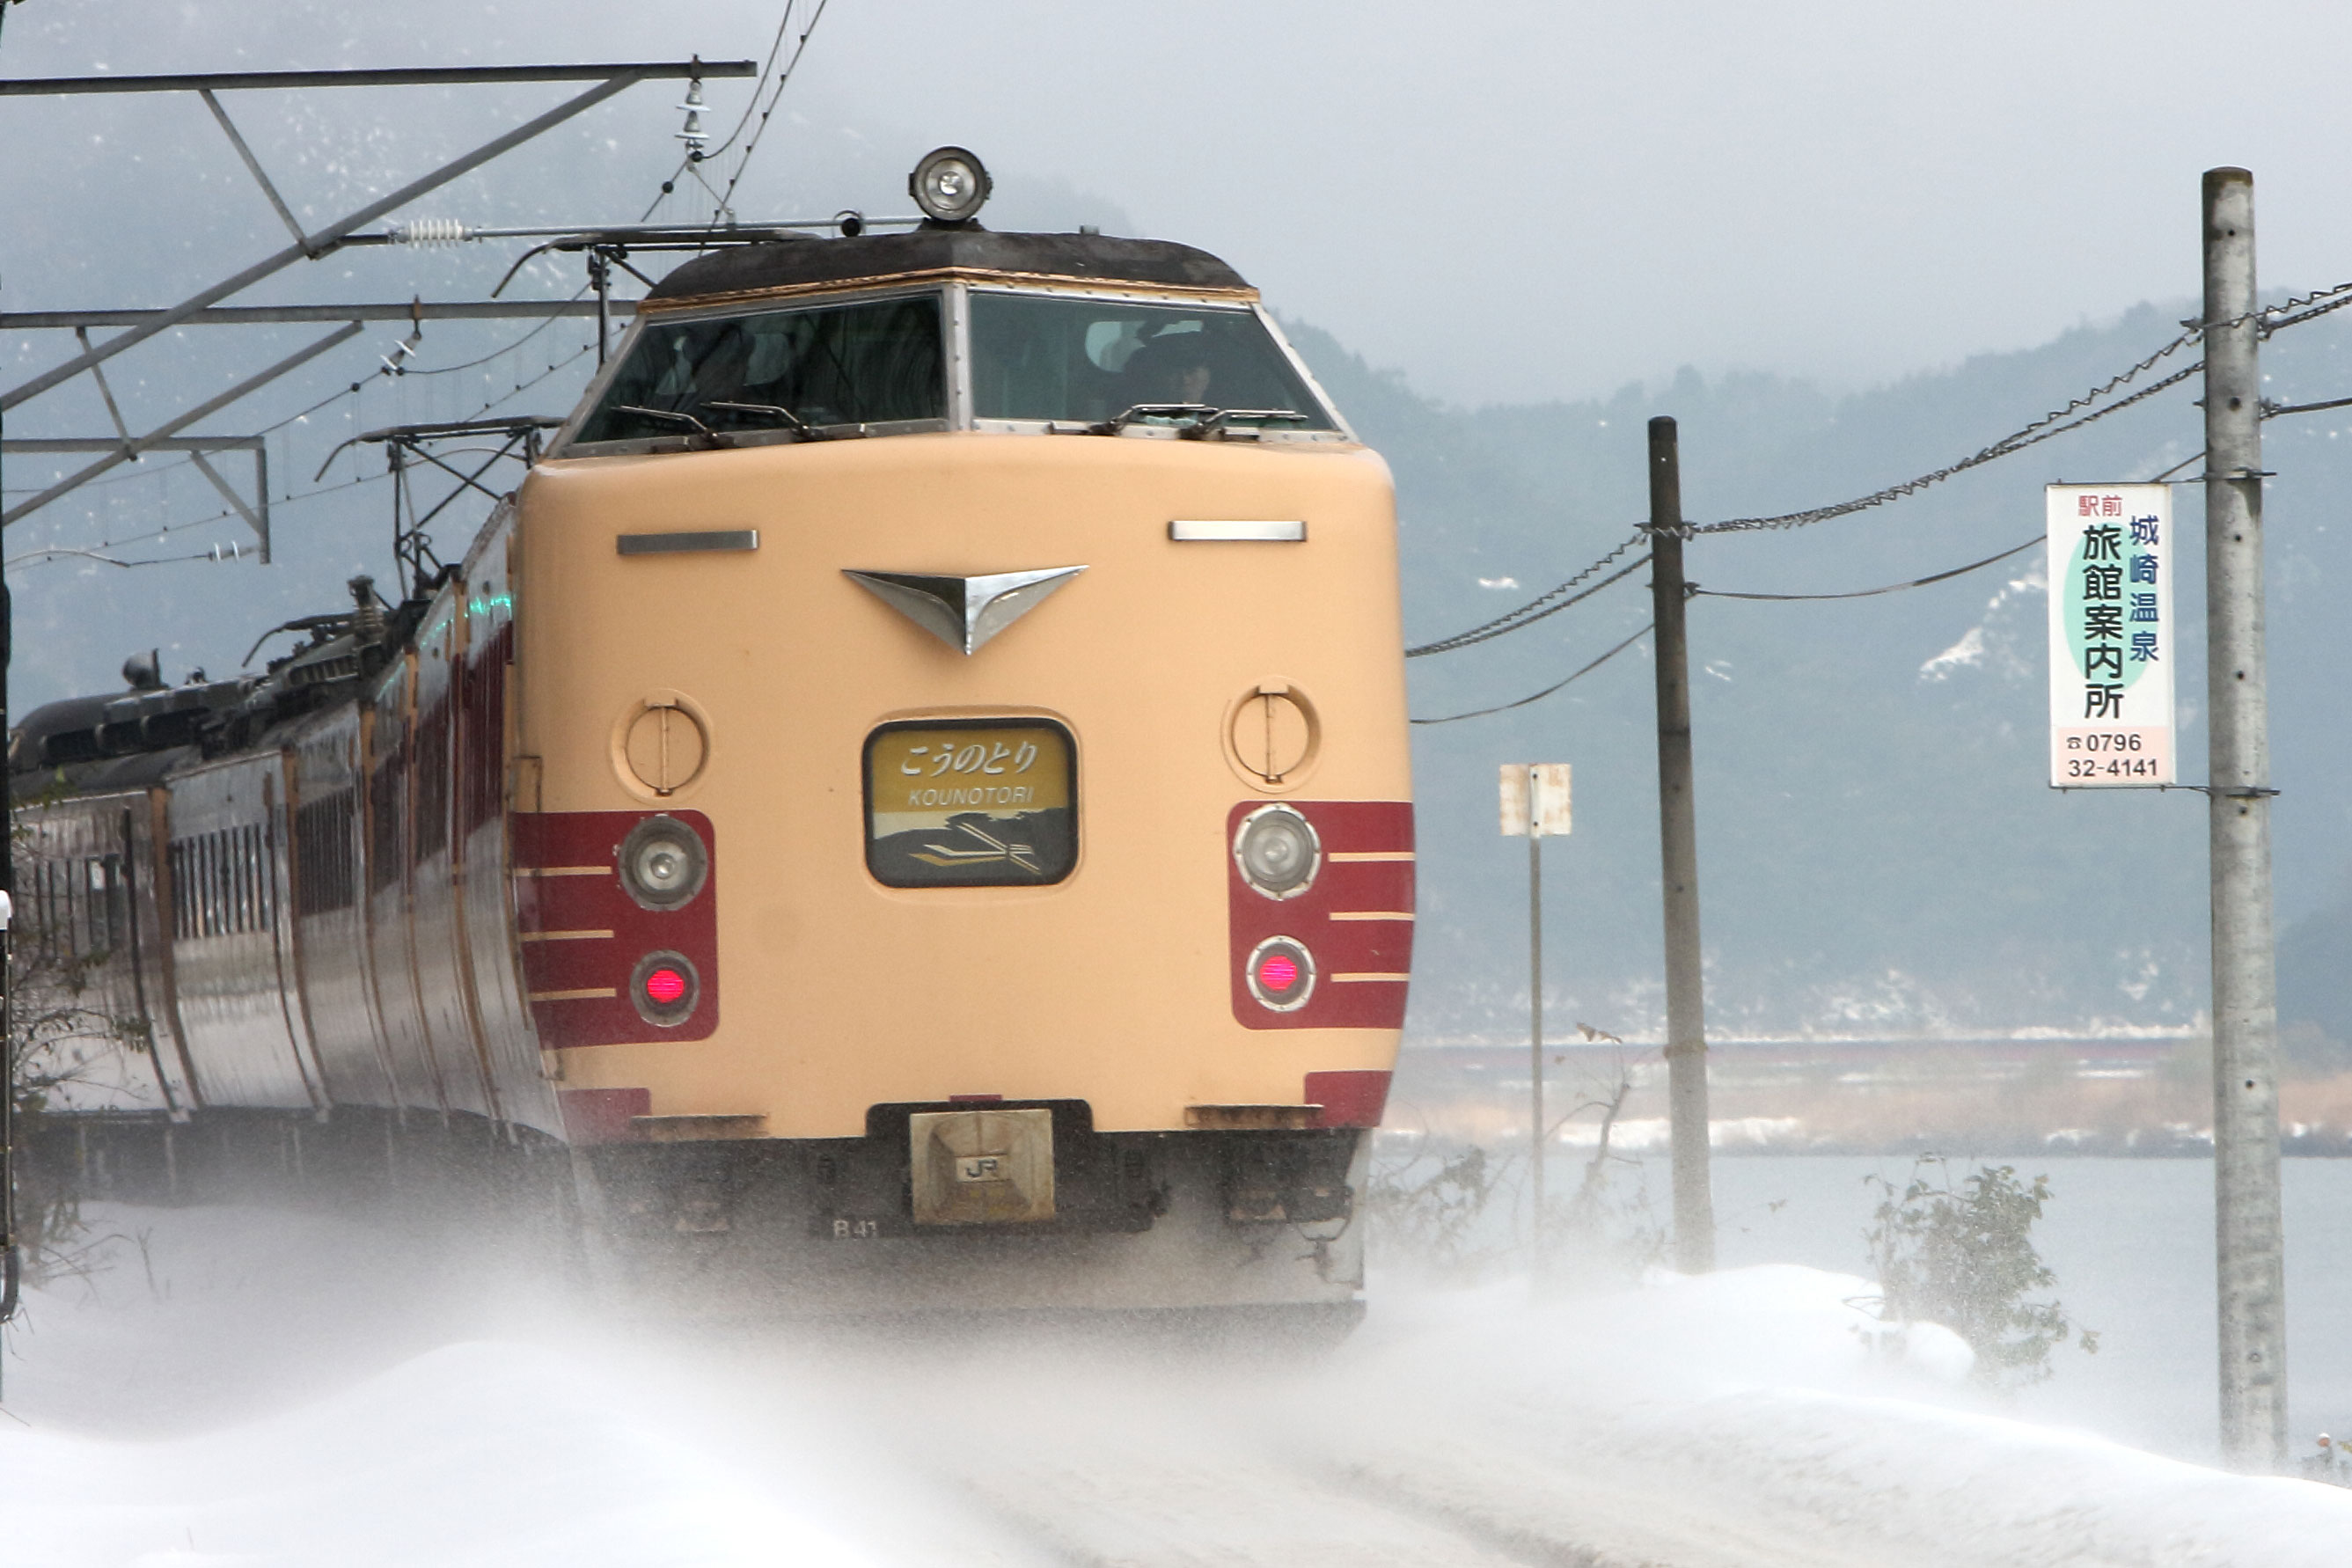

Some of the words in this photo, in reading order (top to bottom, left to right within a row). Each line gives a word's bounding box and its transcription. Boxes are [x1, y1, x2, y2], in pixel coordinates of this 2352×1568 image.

[2078, 495, 2123, 517] 駅前
[2129, 515, 2160, 663] 城崎温泉
[2083, 524, 2125, 720] 旅館案内所
[2086, 734, 2142, 752] 0796
[900, 741, 1038, 777] こうのとり
[2068, 758, 2158, 777] 32-4141
[907, 787, 1035, 806] KOUNOTORI
[965, 1158, 999, 1179] JR
